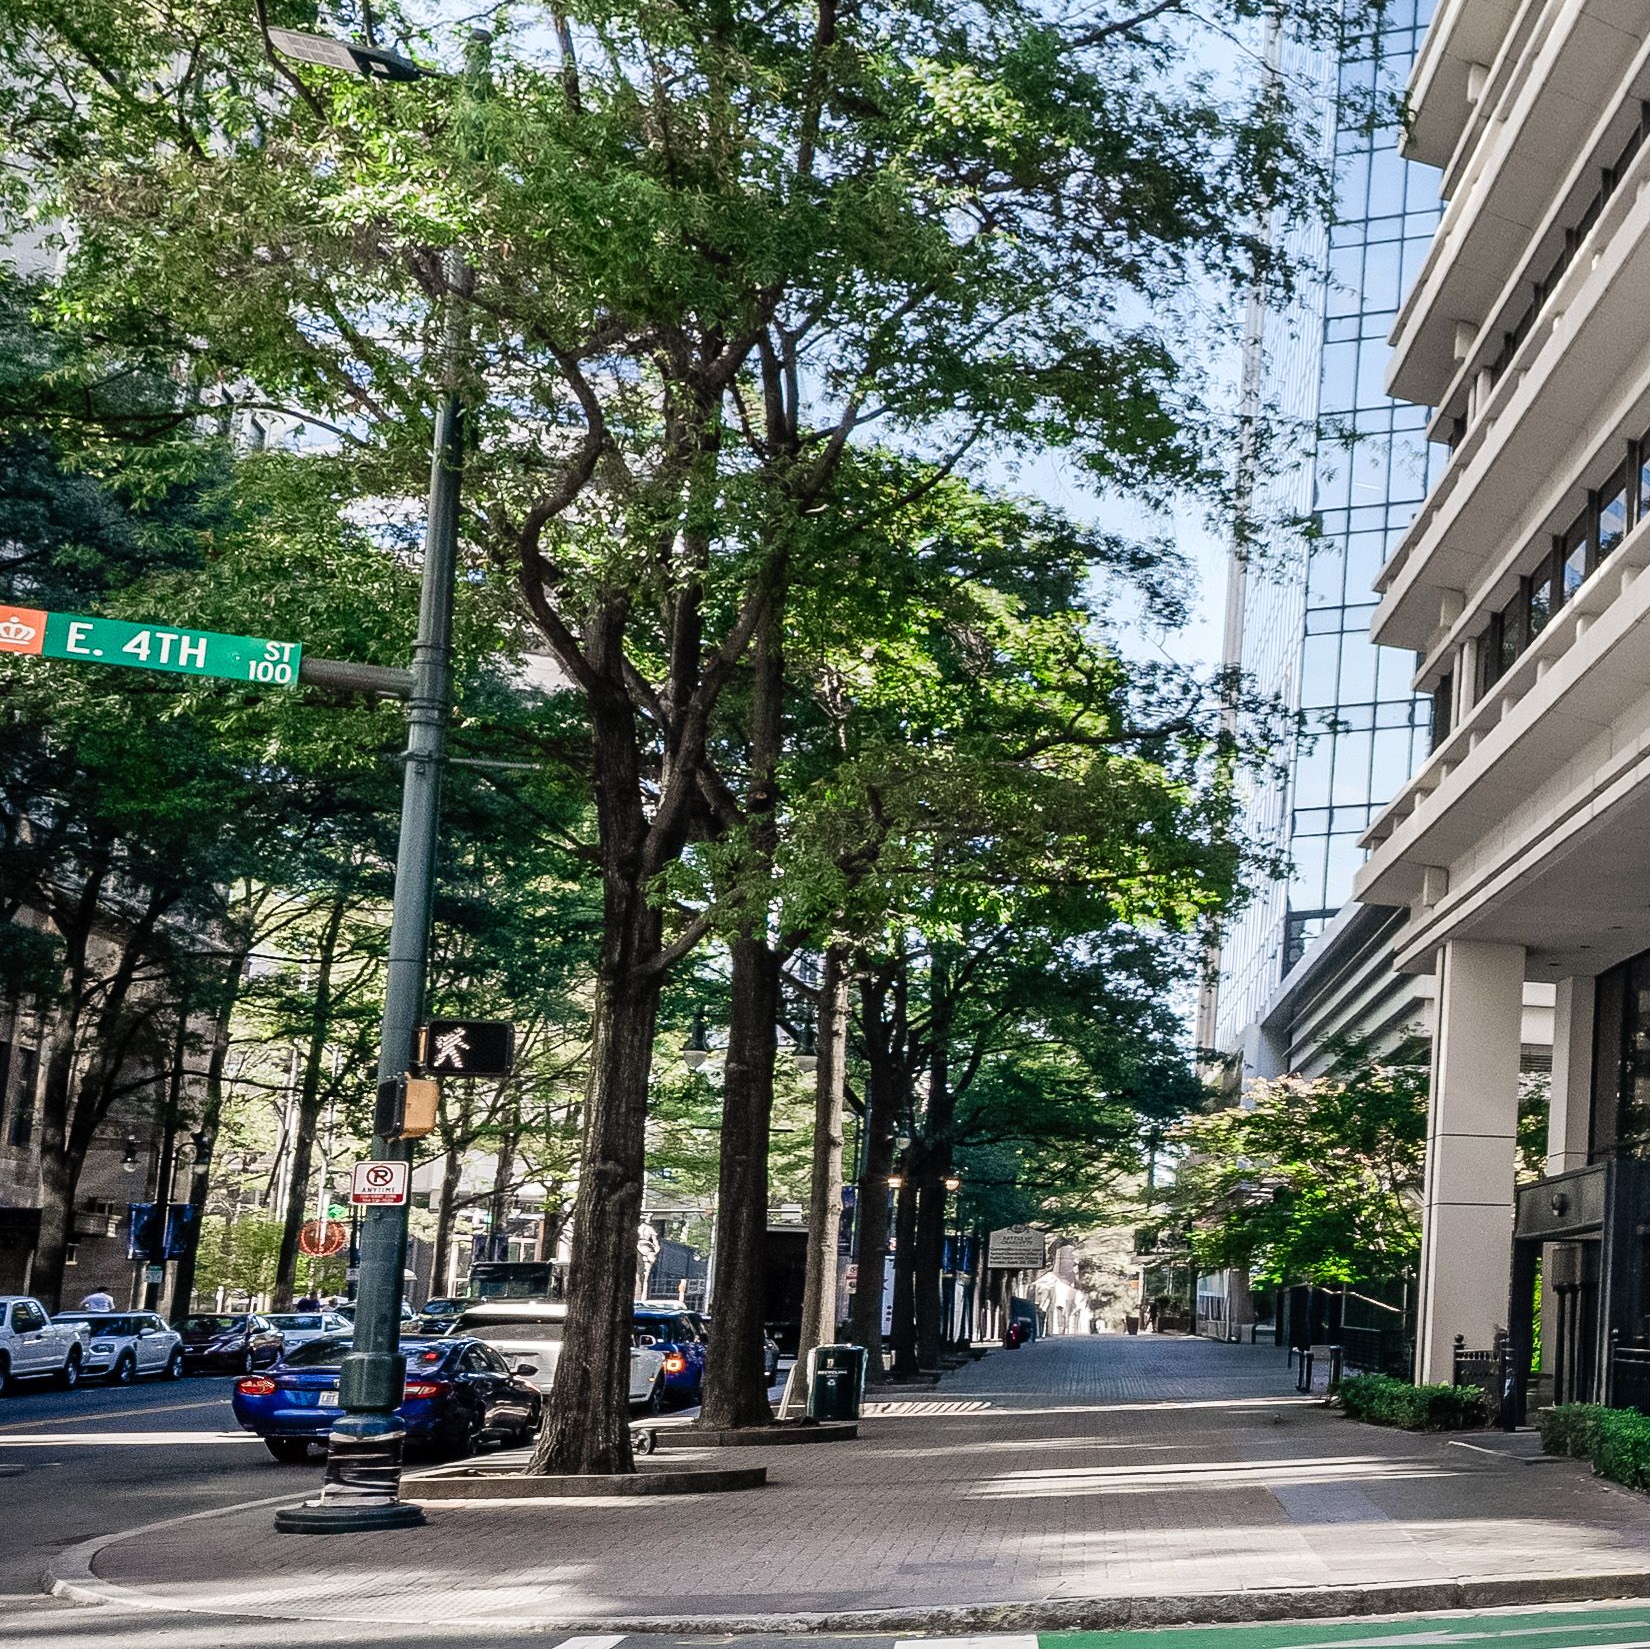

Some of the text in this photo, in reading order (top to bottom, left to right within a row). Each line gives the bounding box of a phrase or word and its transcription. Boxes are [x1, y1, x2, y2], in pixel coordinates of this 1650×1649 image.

[66, 622, 296, 668] E. 4TH ST
[248, 660, 292, 684] 100
